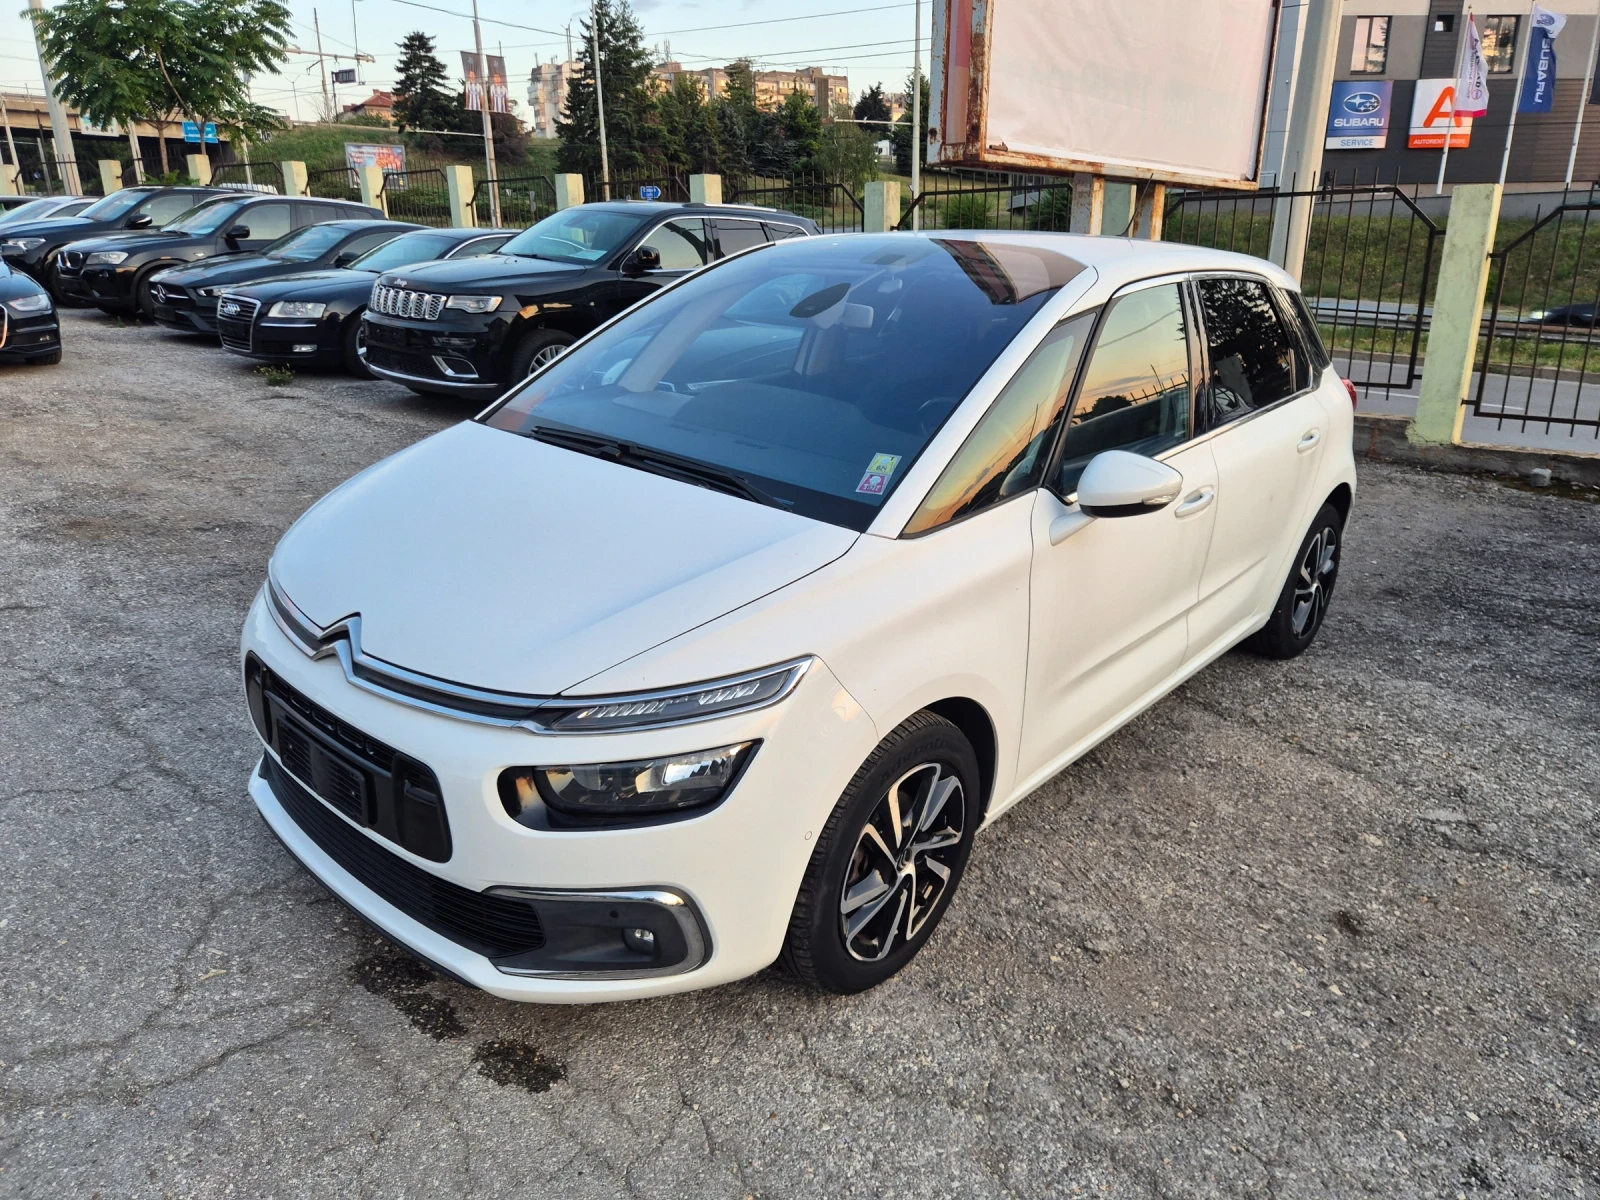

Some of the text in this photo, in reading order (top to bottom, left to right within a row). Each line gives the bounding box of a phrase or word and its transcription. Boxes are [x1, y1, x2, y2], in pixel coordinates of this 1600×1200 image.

[1534, 38, 1550, 103] SUBARU
[1333, 117, 1385, 127] SUBARU
[1340, 138, 1374, 147] SERVICE
